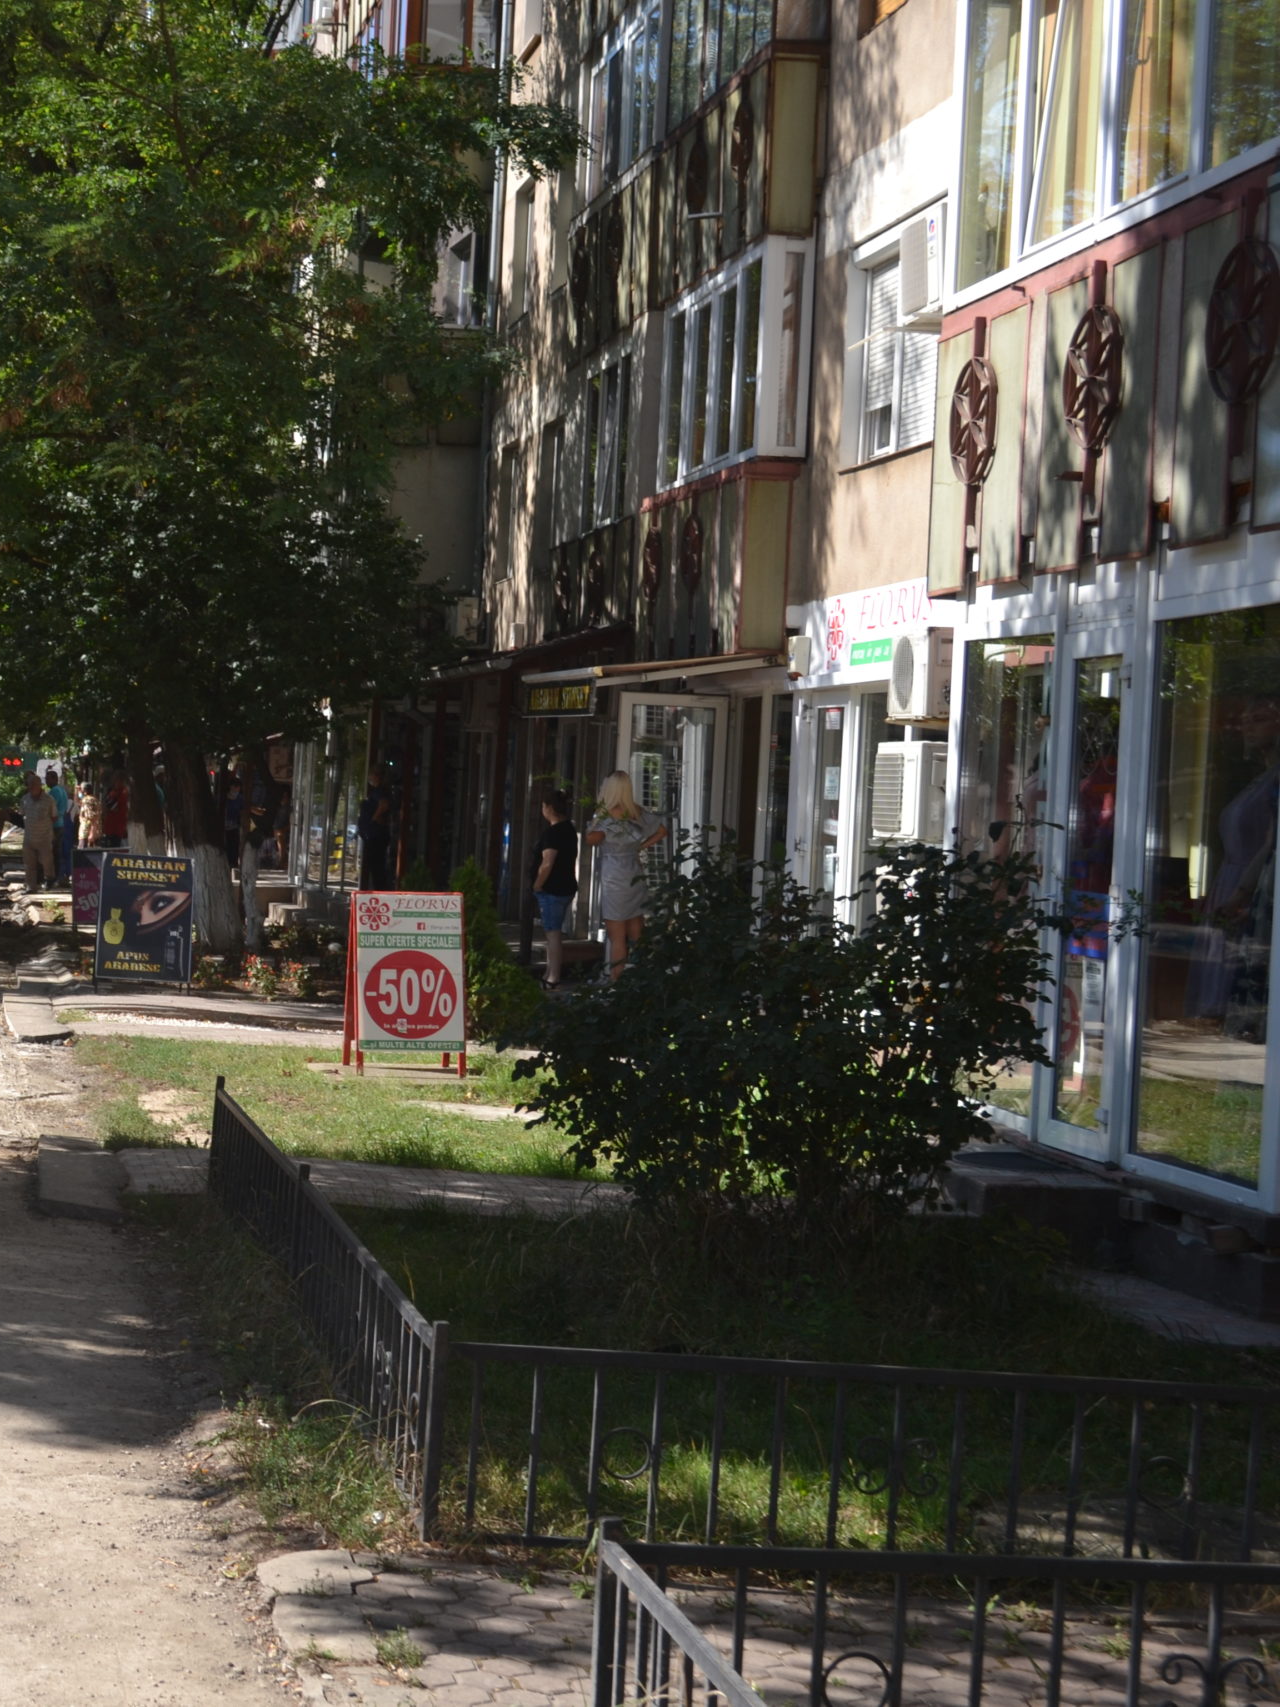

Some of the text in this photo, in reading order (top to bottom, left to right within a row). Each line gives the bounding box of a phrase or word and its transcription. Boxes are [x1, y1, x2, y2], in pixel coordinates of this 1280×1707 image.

[111, 857, 187, 872] ARABIAN
[116, 870, 180, 884] SUNSET
[75, 890, 99, 911] -50
[393, 898, 459, 911] FLORYS
[360, 935, 386, 946] SUPER
[387, 935, 415, 947] OFERTE
[366, 969, 452, 1017] -50%
[378, 1041, 404, 1049] MULTE
